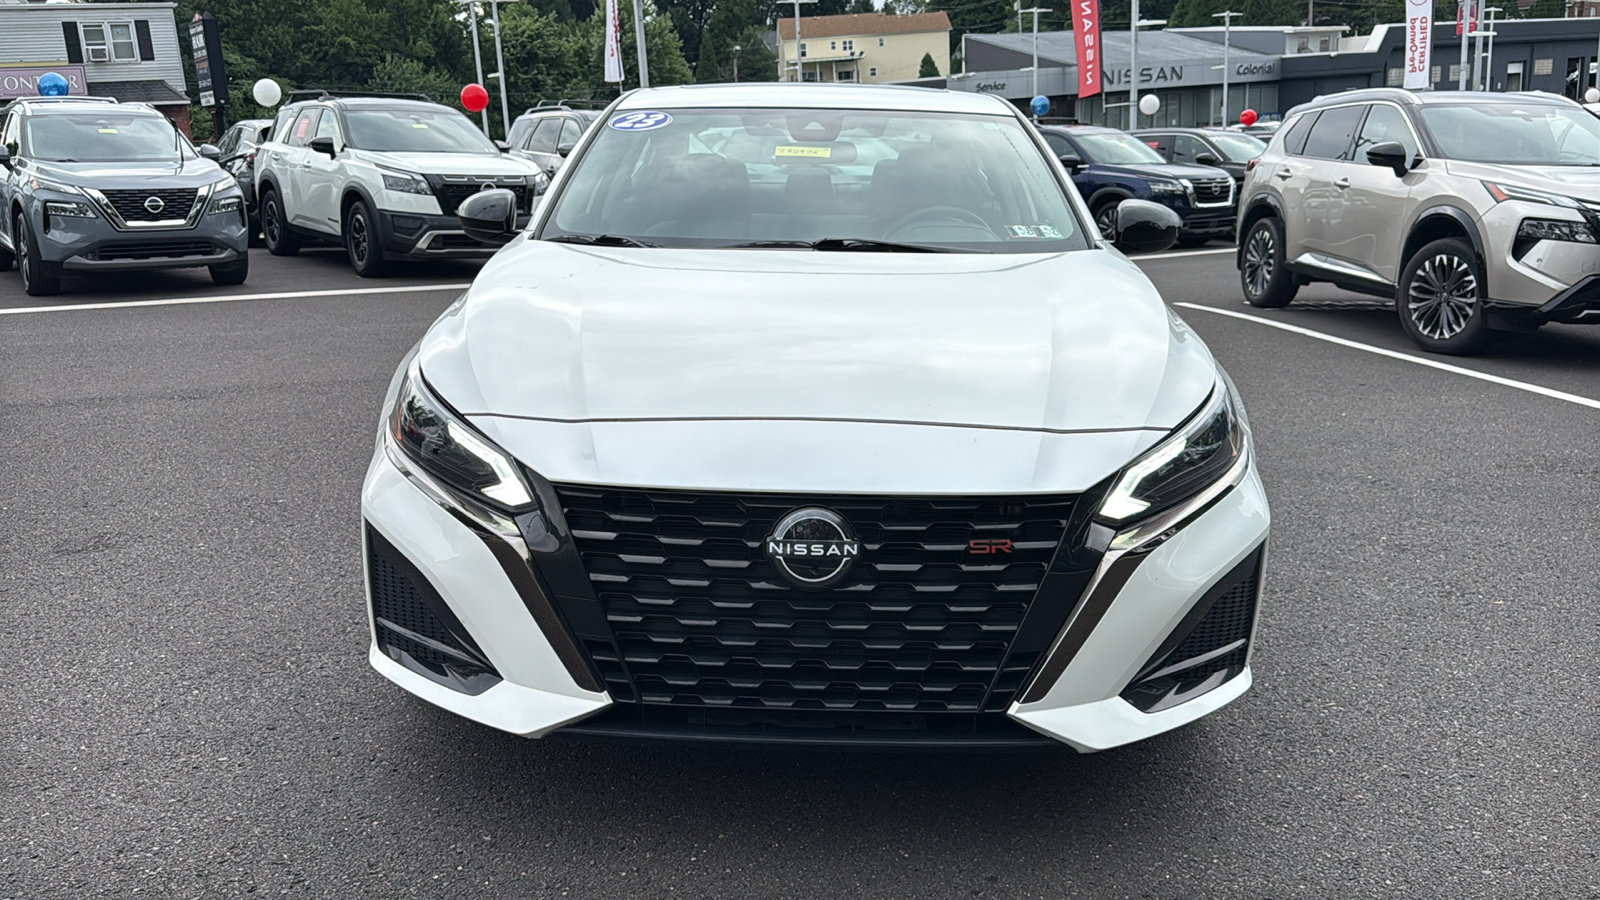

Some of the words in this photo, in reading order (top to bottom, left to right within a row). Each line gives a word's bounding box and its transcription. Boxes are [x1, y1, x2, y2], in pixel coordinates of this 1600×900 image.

[1102, 66, 1183, 85] NISSAN
[1236, 62, 1276, 75] Colonial
[975, 81, 1006, 92] Service
[614, 113, 665, 128] 23
[768, 541, 858, 556] NISSAN
[969, 539, 1012, 554] SR
